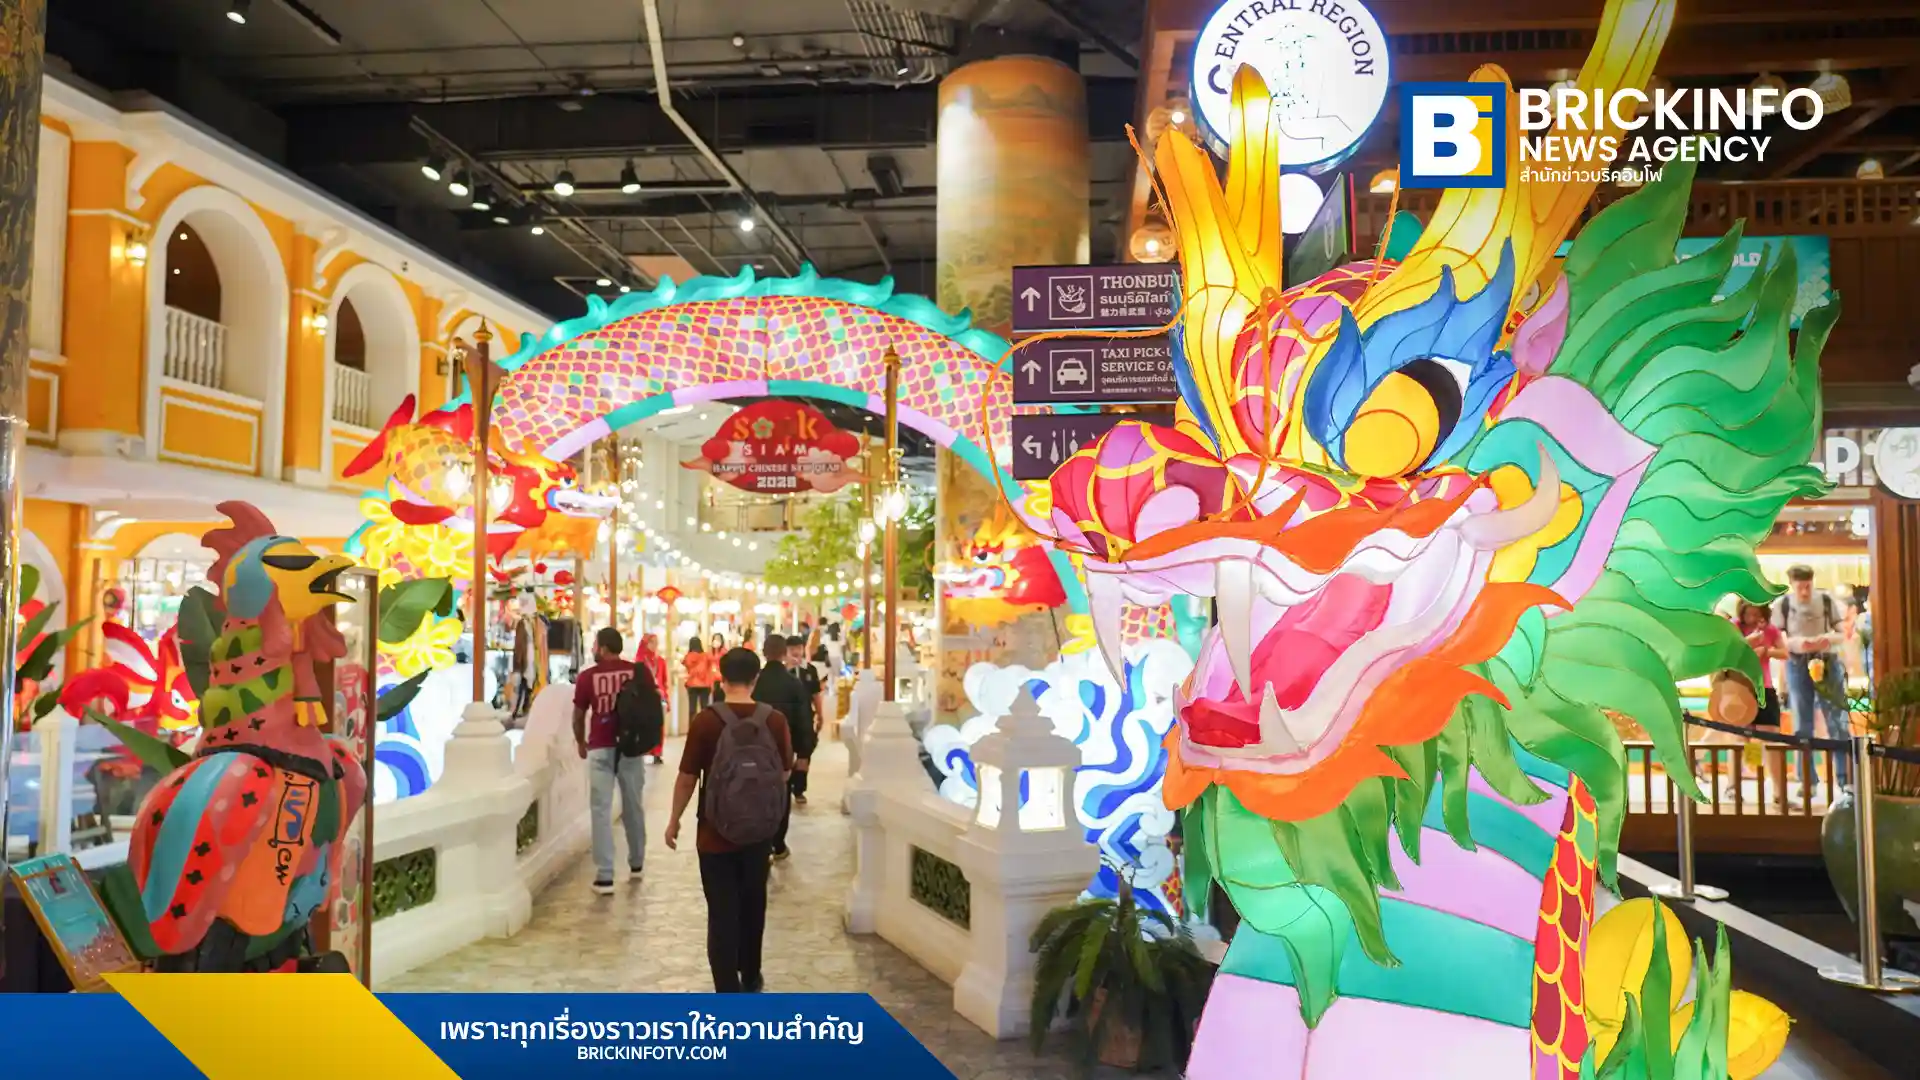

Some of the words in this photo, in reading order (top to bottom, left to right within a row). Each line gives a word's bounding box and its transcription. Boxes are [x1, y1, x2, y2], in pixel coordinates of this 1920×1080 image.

[1207, 0, 1301, 95] CENTRAL
[1308, 0, 1375, 77] REGION
[1101, 348, 1130, 359] TAXI
[1133, 347, 1173, 358] PICK-U
[1101, 361, 1154, 373] SERVICE
[1157, 360, 1174, 372] GA
[743, 443, 808, 456] SIAM
